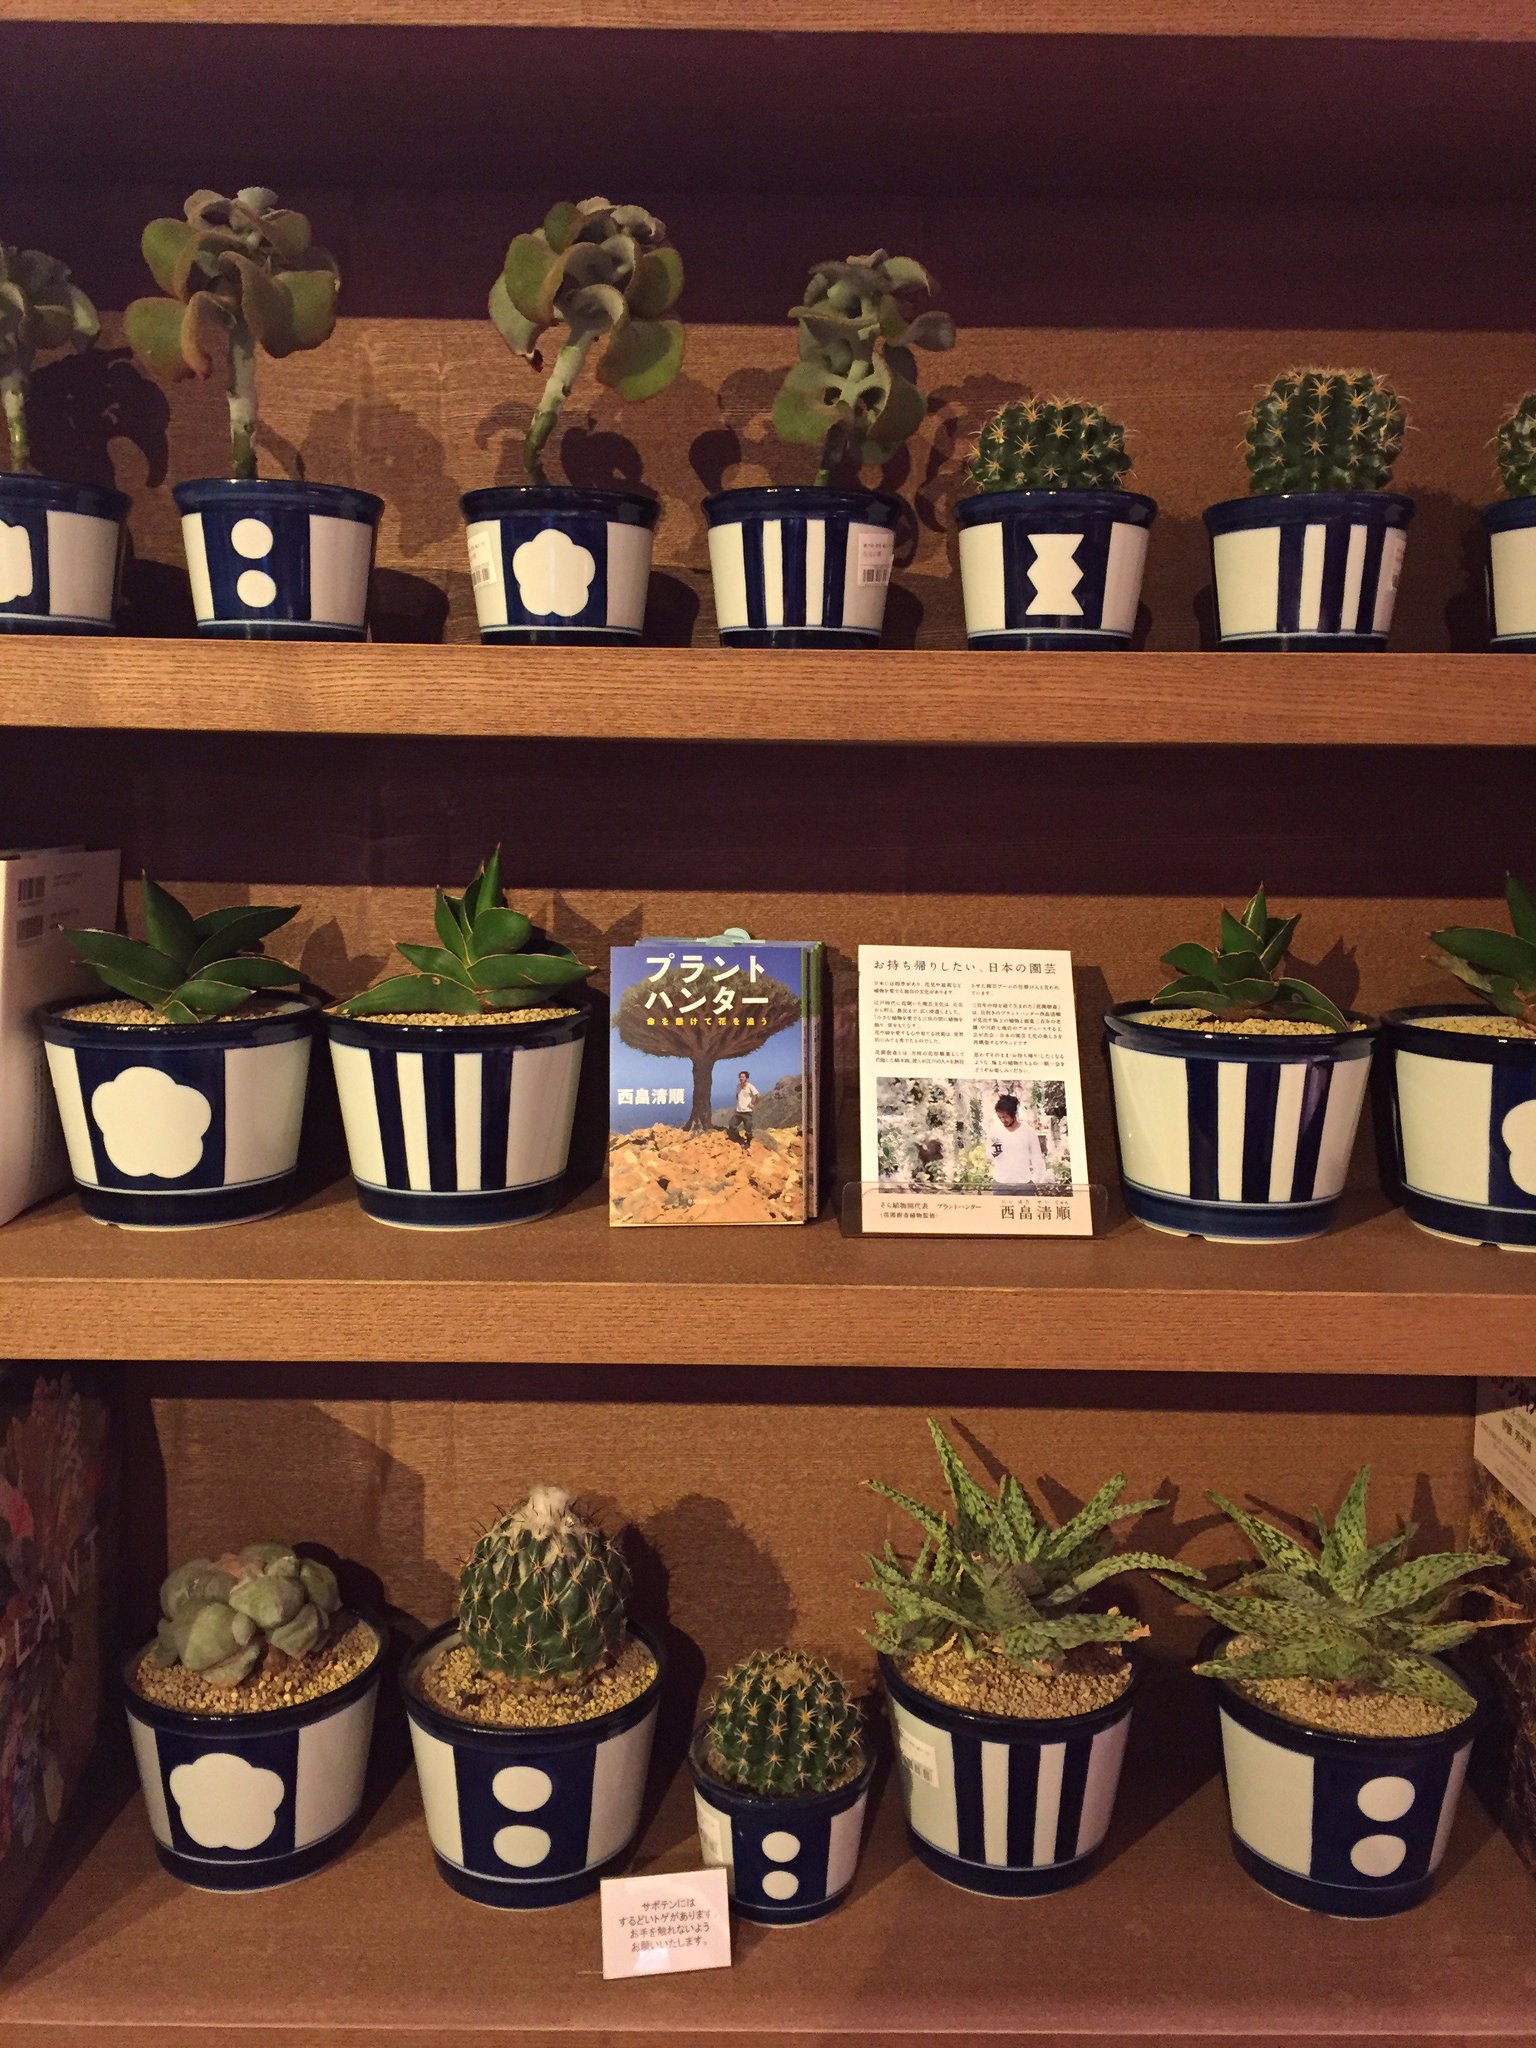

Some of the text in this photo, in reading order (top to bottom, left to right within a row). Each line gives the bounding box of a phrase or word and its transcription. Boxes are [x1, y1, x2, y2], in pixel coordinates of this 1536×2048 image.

[646, 952, 766, 984] プラント
[873, 959, 1057, 975] お持ち帰りしたい、日本の園芸
[644, 986, 769, 1015] ハンター
[617, 1088, 686, 1106] 西畠清順
[1000, 1204, 1072, 1221] 西畠清順
[641, 1898, 696, 1912] サボテンには
[630, 1922, 710, 1940] お手を触れないよう
